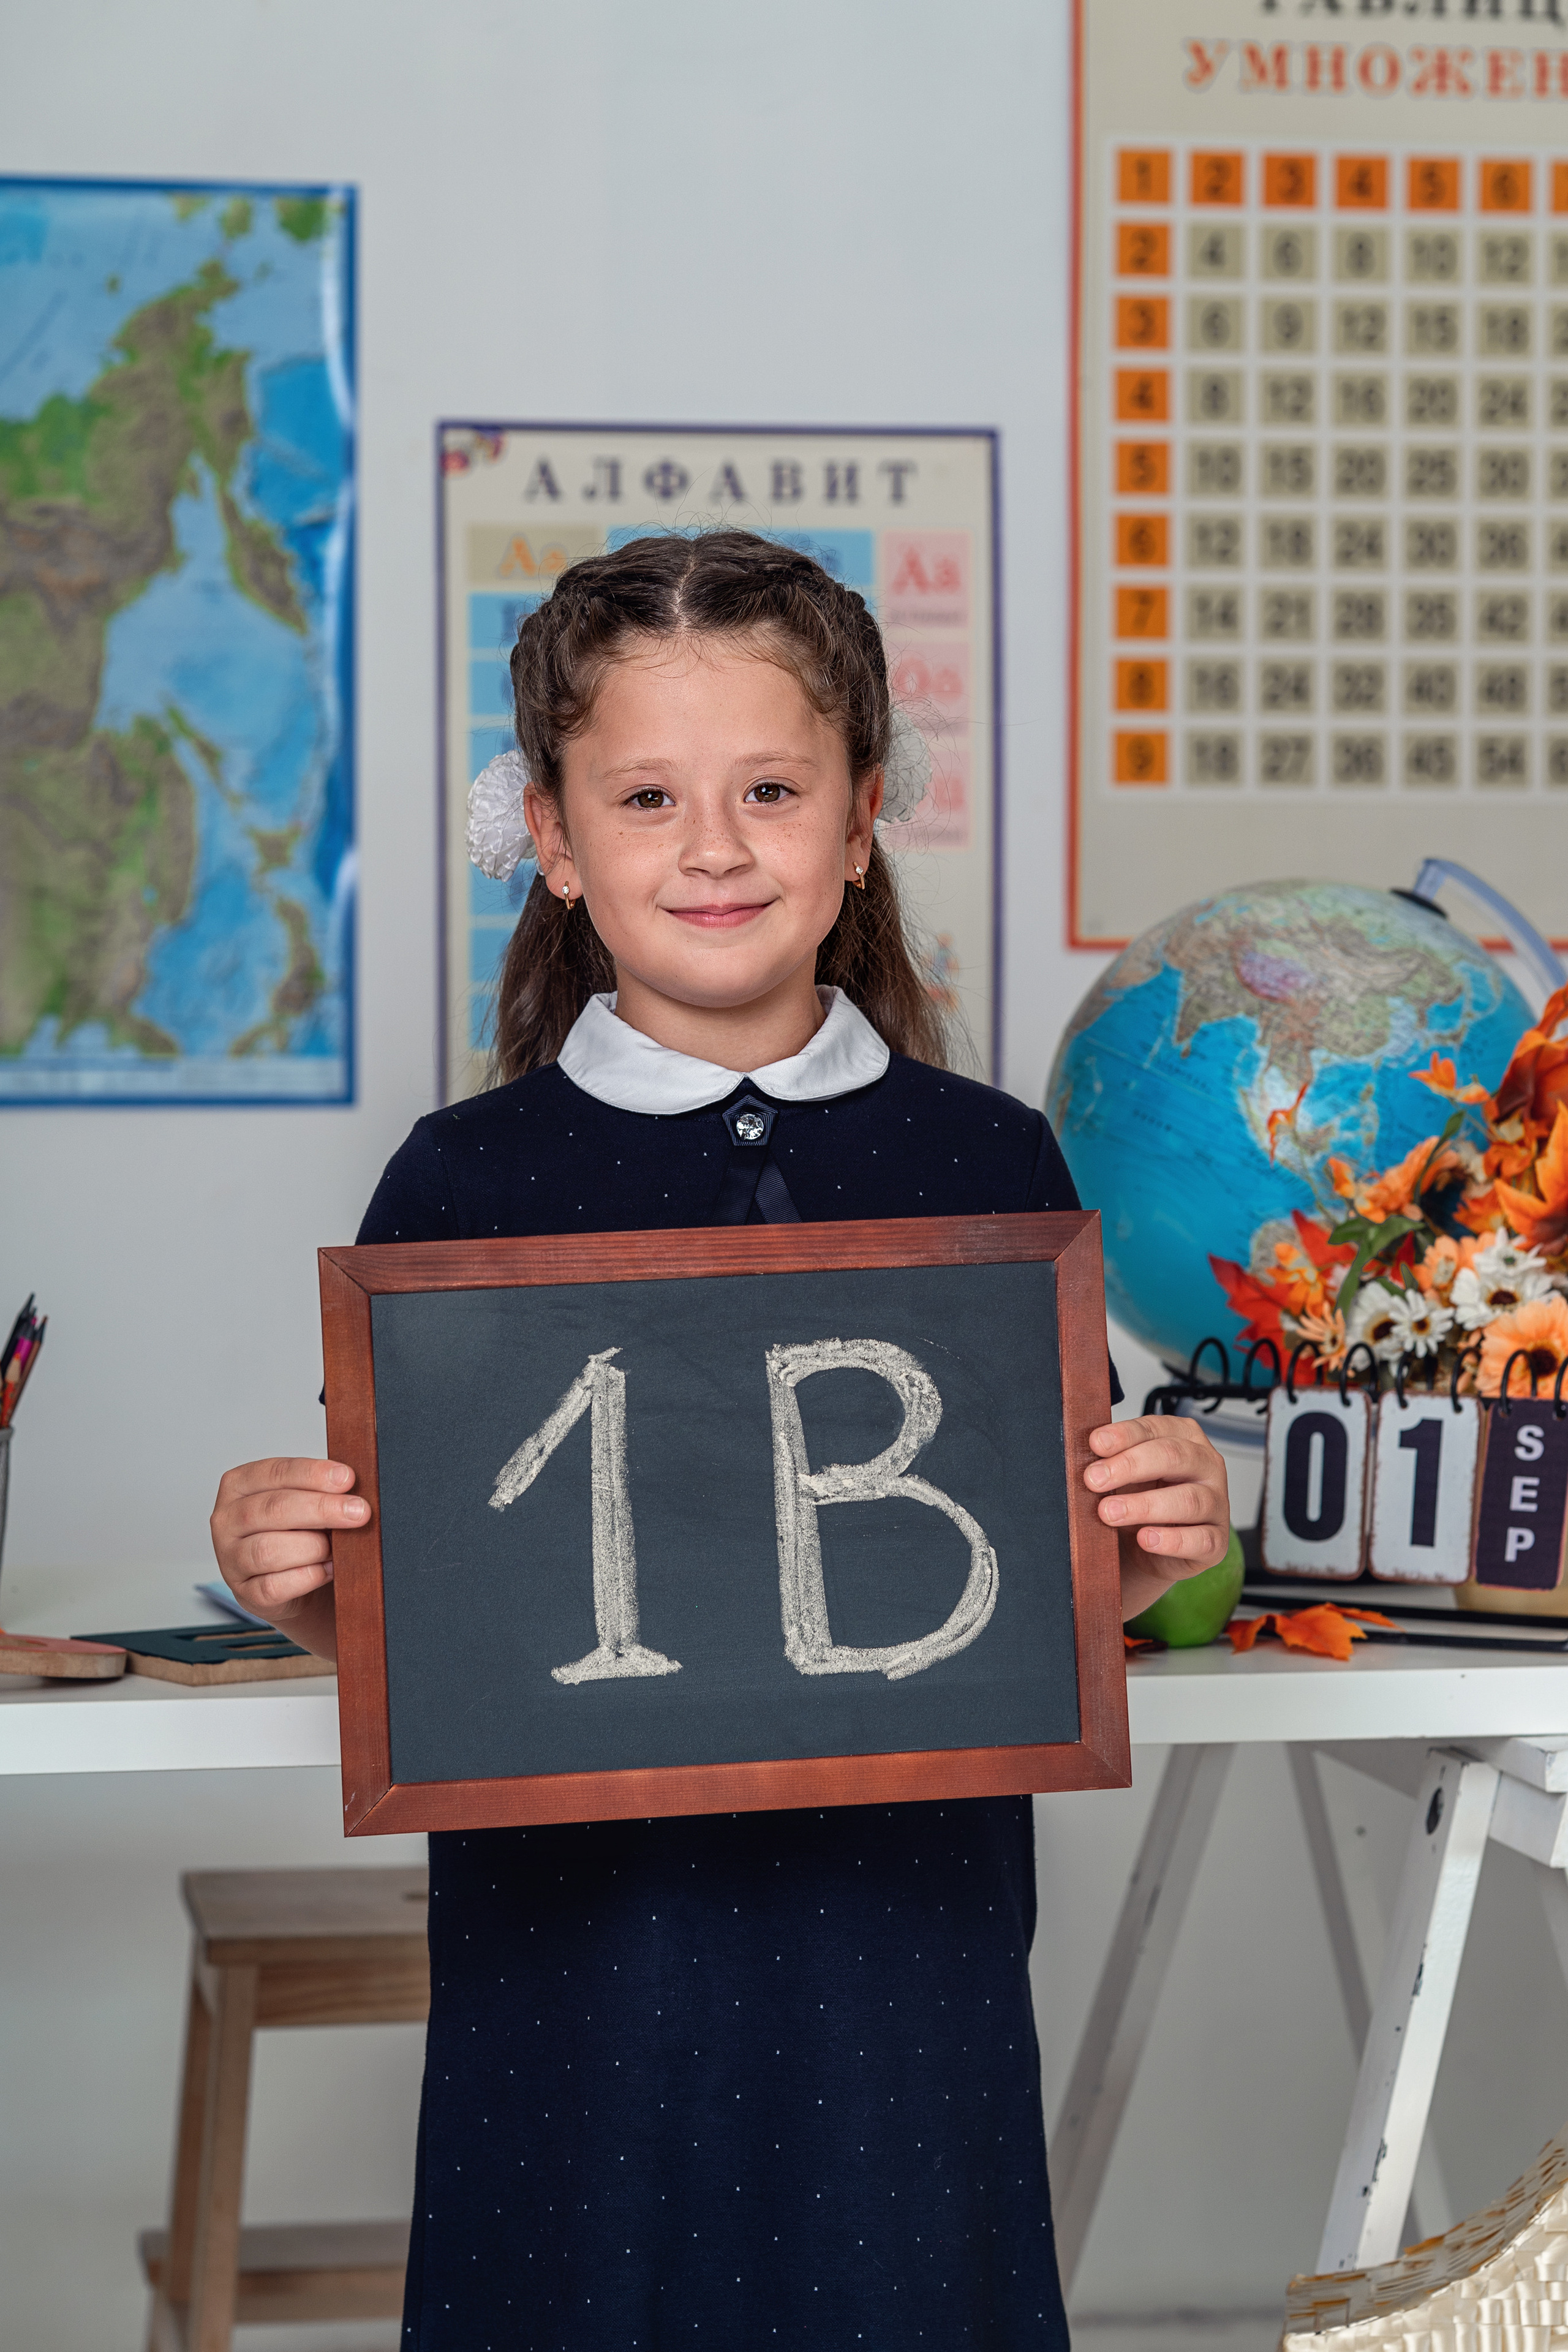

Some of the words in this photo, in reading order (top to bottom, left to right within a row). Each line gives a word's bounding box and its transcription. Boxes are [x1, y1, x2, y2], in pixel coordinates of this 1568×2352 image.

[1133, 156, 1153, 197] 1
[1205, 159, 1231, 201] 2
[1280, 160, 1305, 202] 3
[1348, 164, 1374, 202] 4
[1420, 163, 1445, 205] 5
[1492, 166, 1517, 207] 6
[1131, 230, 1156, 272] 2
[1132, 302, 1155, 344] 3
[1129, 376, 1156, 414] 4
[525, 456, 918, 506] АЛФАВИТ
[1131, 445, 1155, 488] 5
[1129, 521, 1155, 561] 6
[1132, 590, 1155, 630] 7
[1129, 665, 1153, 706] 8
[1128, 737, 1154, 778] 9
[1504, 1424, 1545, 1563] SEP
[488, 1347, 683, 1684] 1
